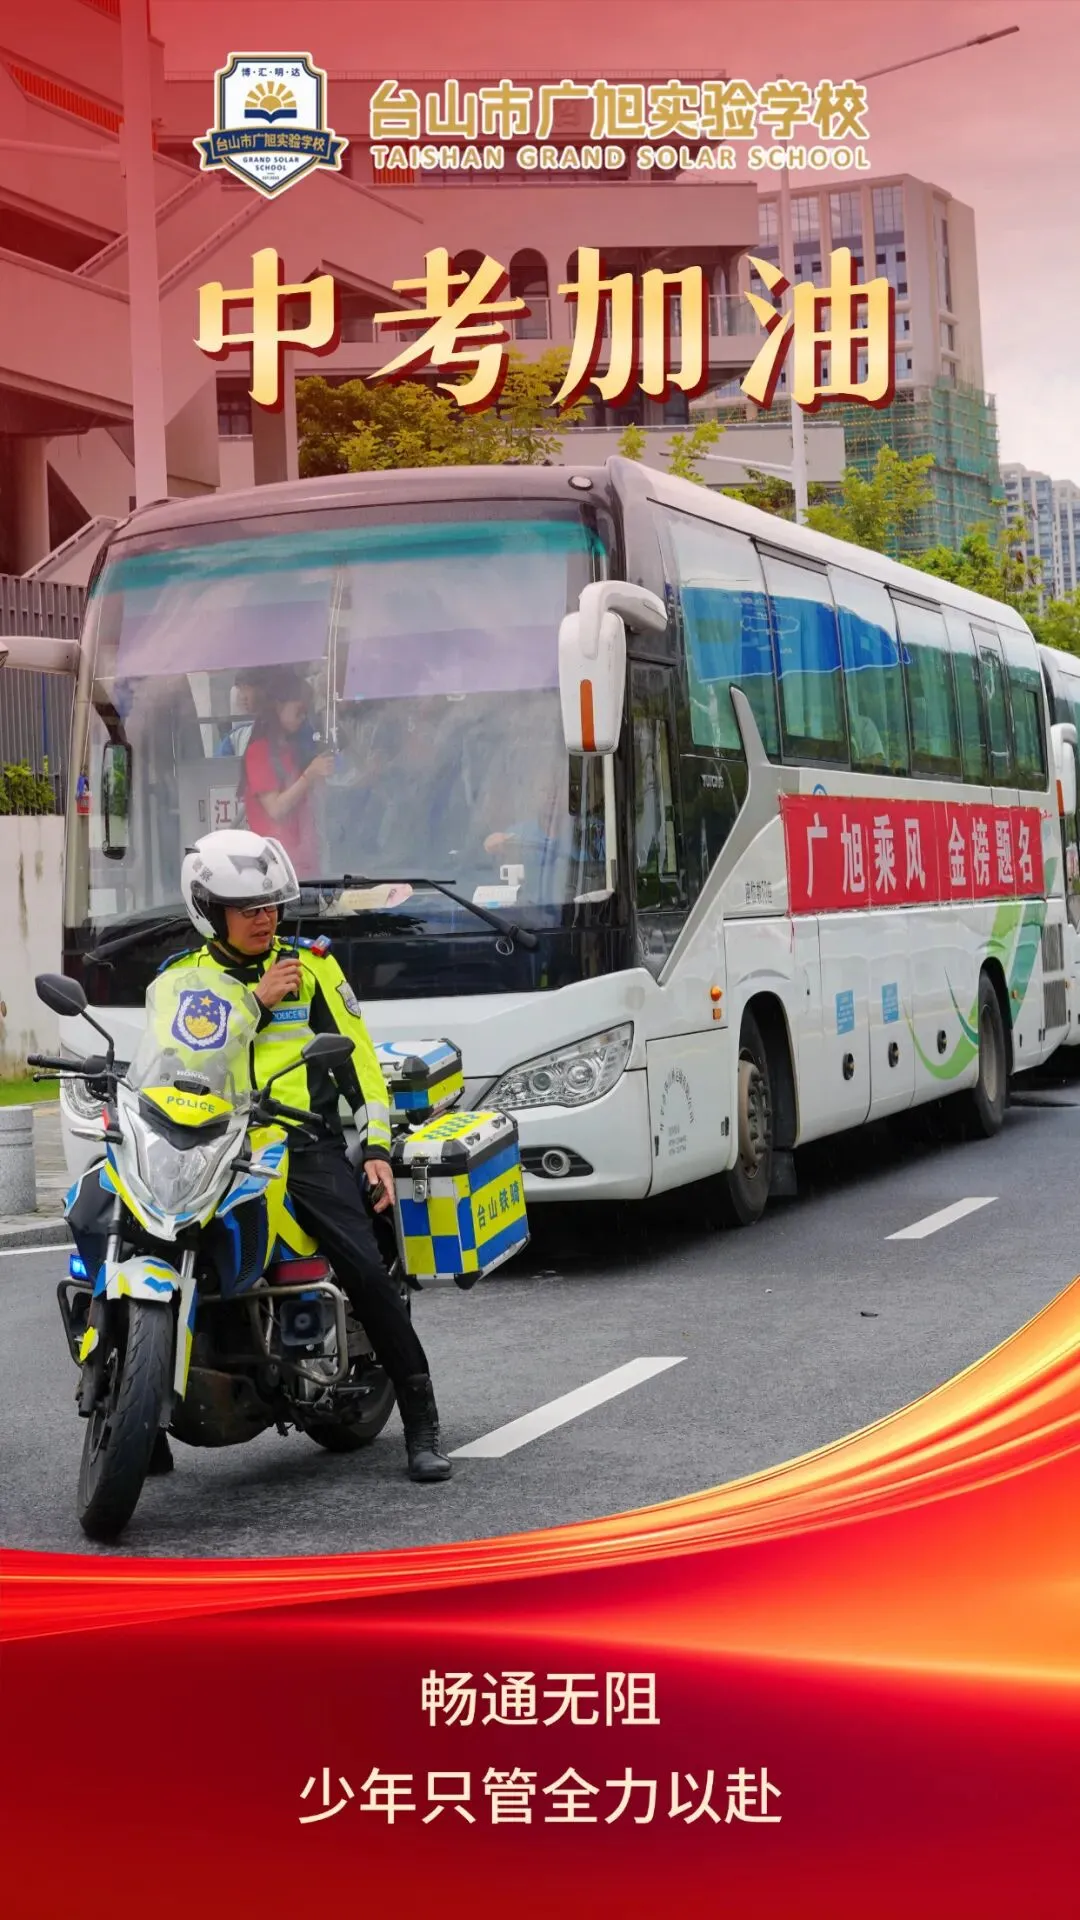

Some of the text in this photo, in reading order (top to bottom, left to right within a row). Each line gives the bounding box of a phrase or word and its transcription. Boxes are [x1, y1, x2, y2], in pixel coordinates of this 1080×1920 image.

[805, 812, 1034, 898] 广旭乘风 金榜题名
[166, 1095, 216, 1114] POLICE
